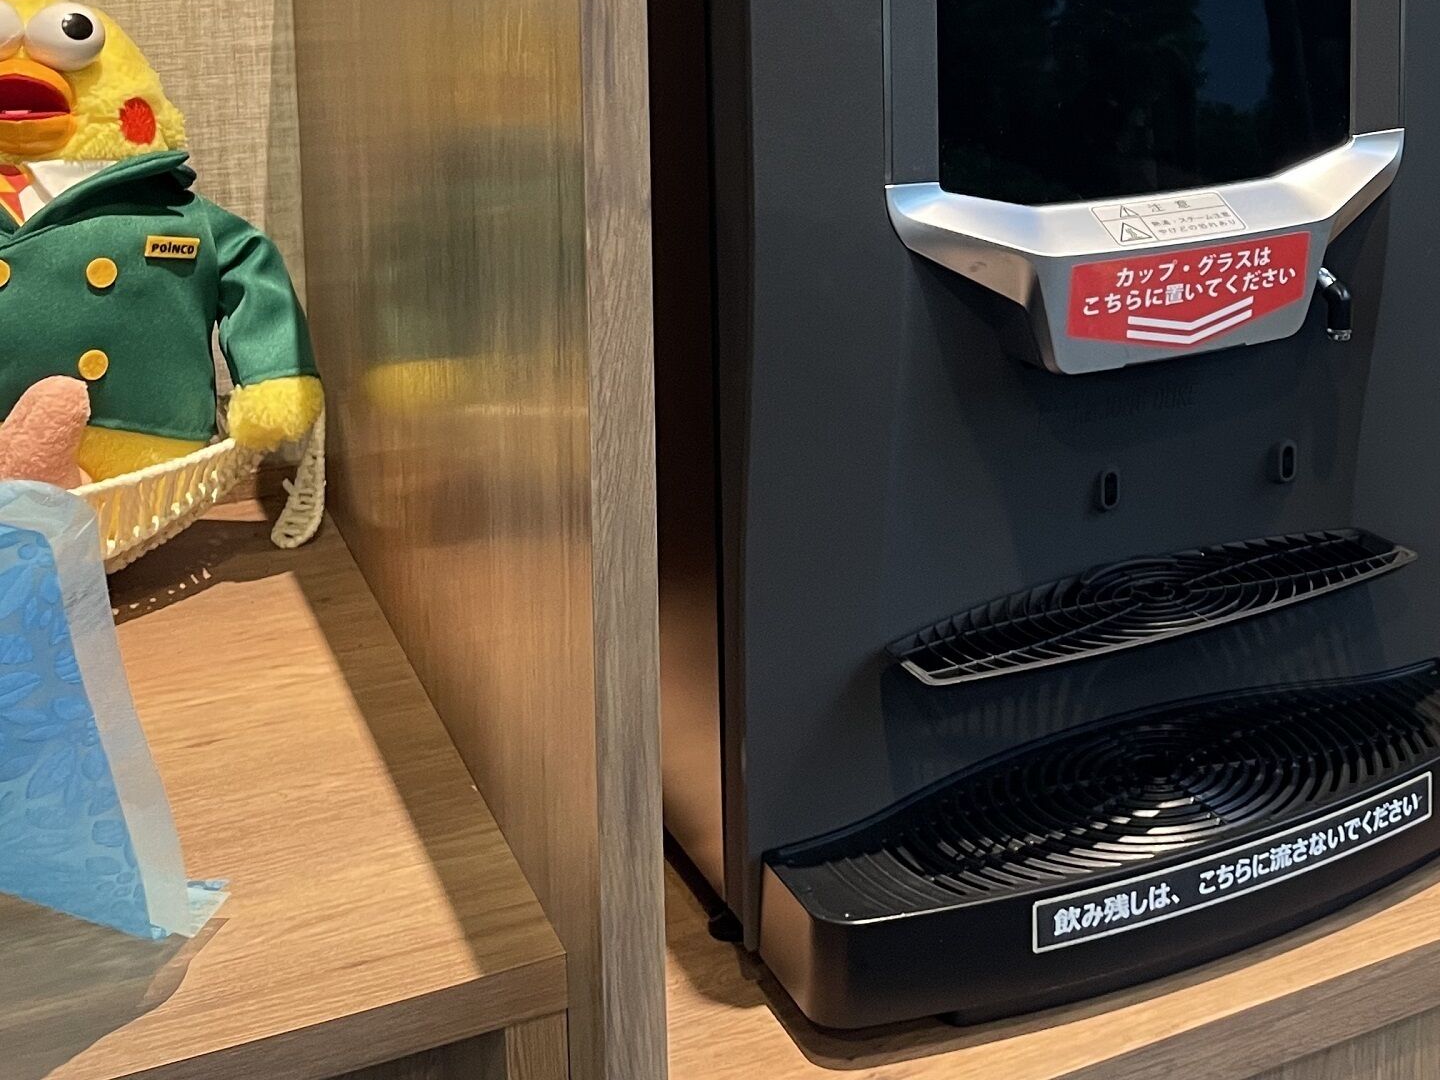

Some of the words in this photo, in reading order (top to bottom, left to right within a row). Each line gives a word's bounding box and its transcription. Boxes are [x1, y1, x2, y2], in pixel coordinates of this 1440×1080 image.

[1115, 246, 1271, 288] カップ・グラスは
[1082, 266, 1297, 316] こちらに置いてください
